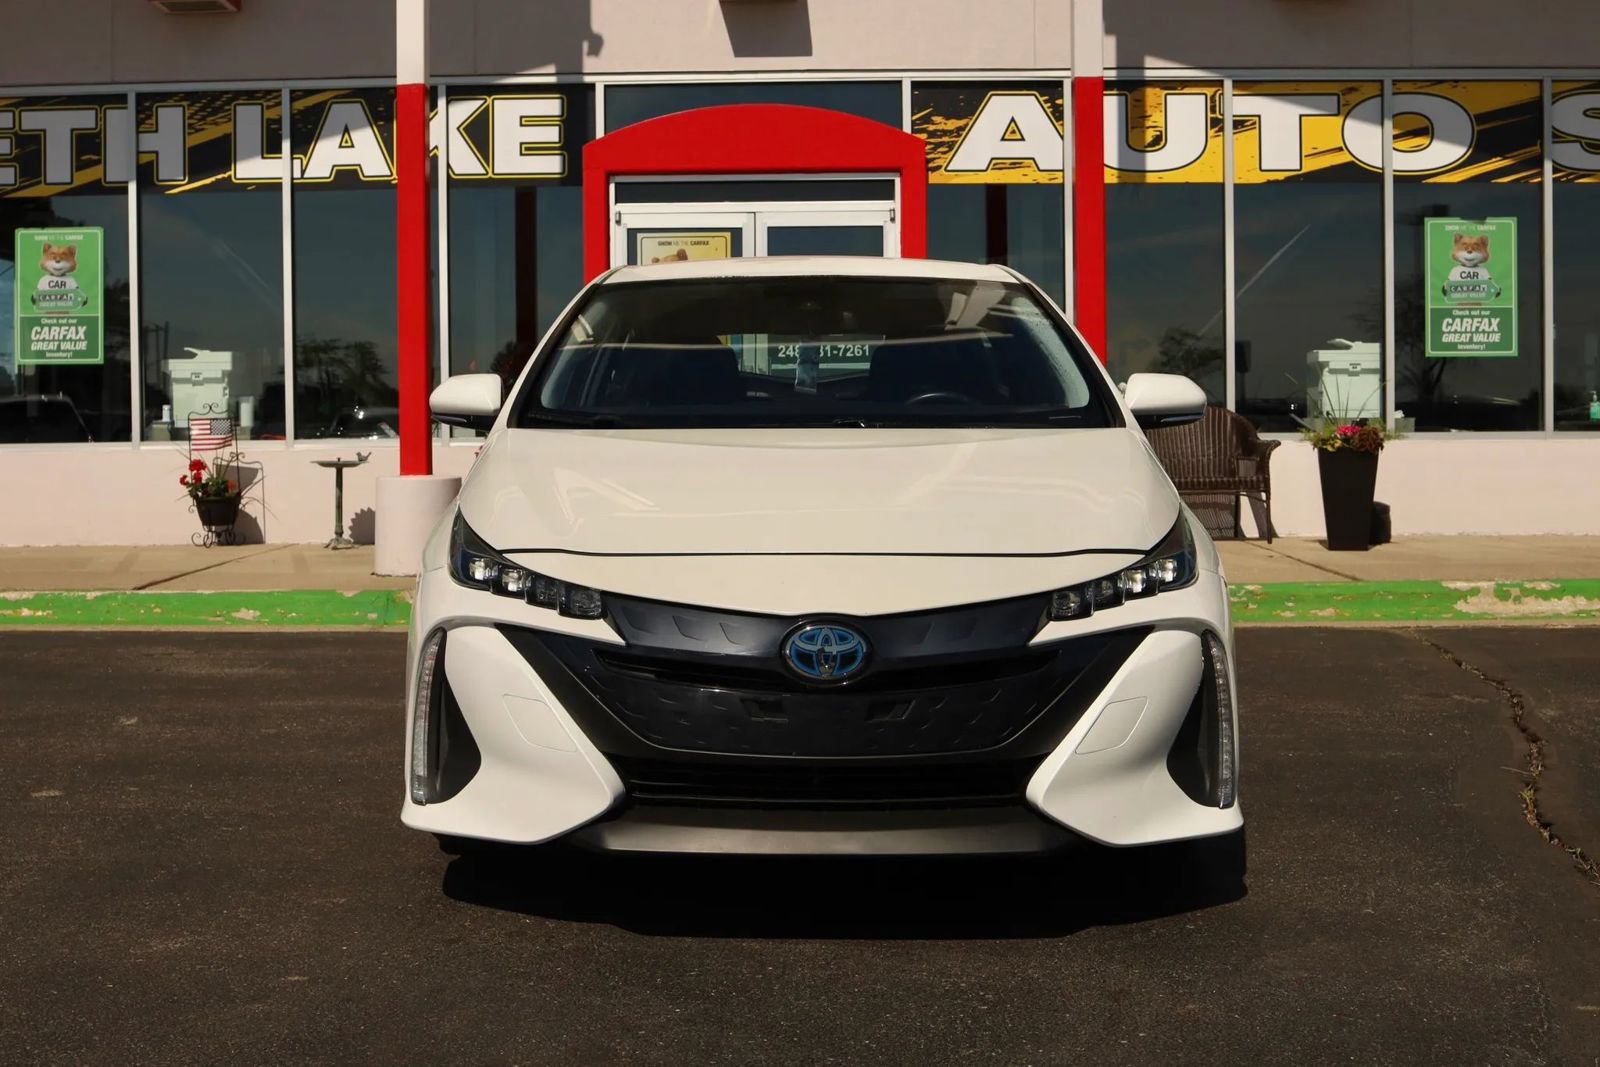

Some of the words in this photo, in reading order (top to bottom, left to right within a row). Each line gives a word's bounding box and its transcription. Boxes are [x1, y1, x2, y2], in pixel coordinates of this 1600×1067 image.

[0, 104, 188, 186] TH
[232, 94, 567, 182] LAKE
[943, 91, 1476, 173] AUTO
[1460, 270, 1479, 280] CAR
[48, 280, 67, 289] CAR
[1442, 317, 1500, 333] CARFAX
[31, 325, 87, 341] CARFAX
[1442, 332, 1472, 343] GREAT
[1472, 332, 1501, 343] VALUE
[31, 340, 59, 351] GREAT
[60, 340, 88, 351] VALUE
